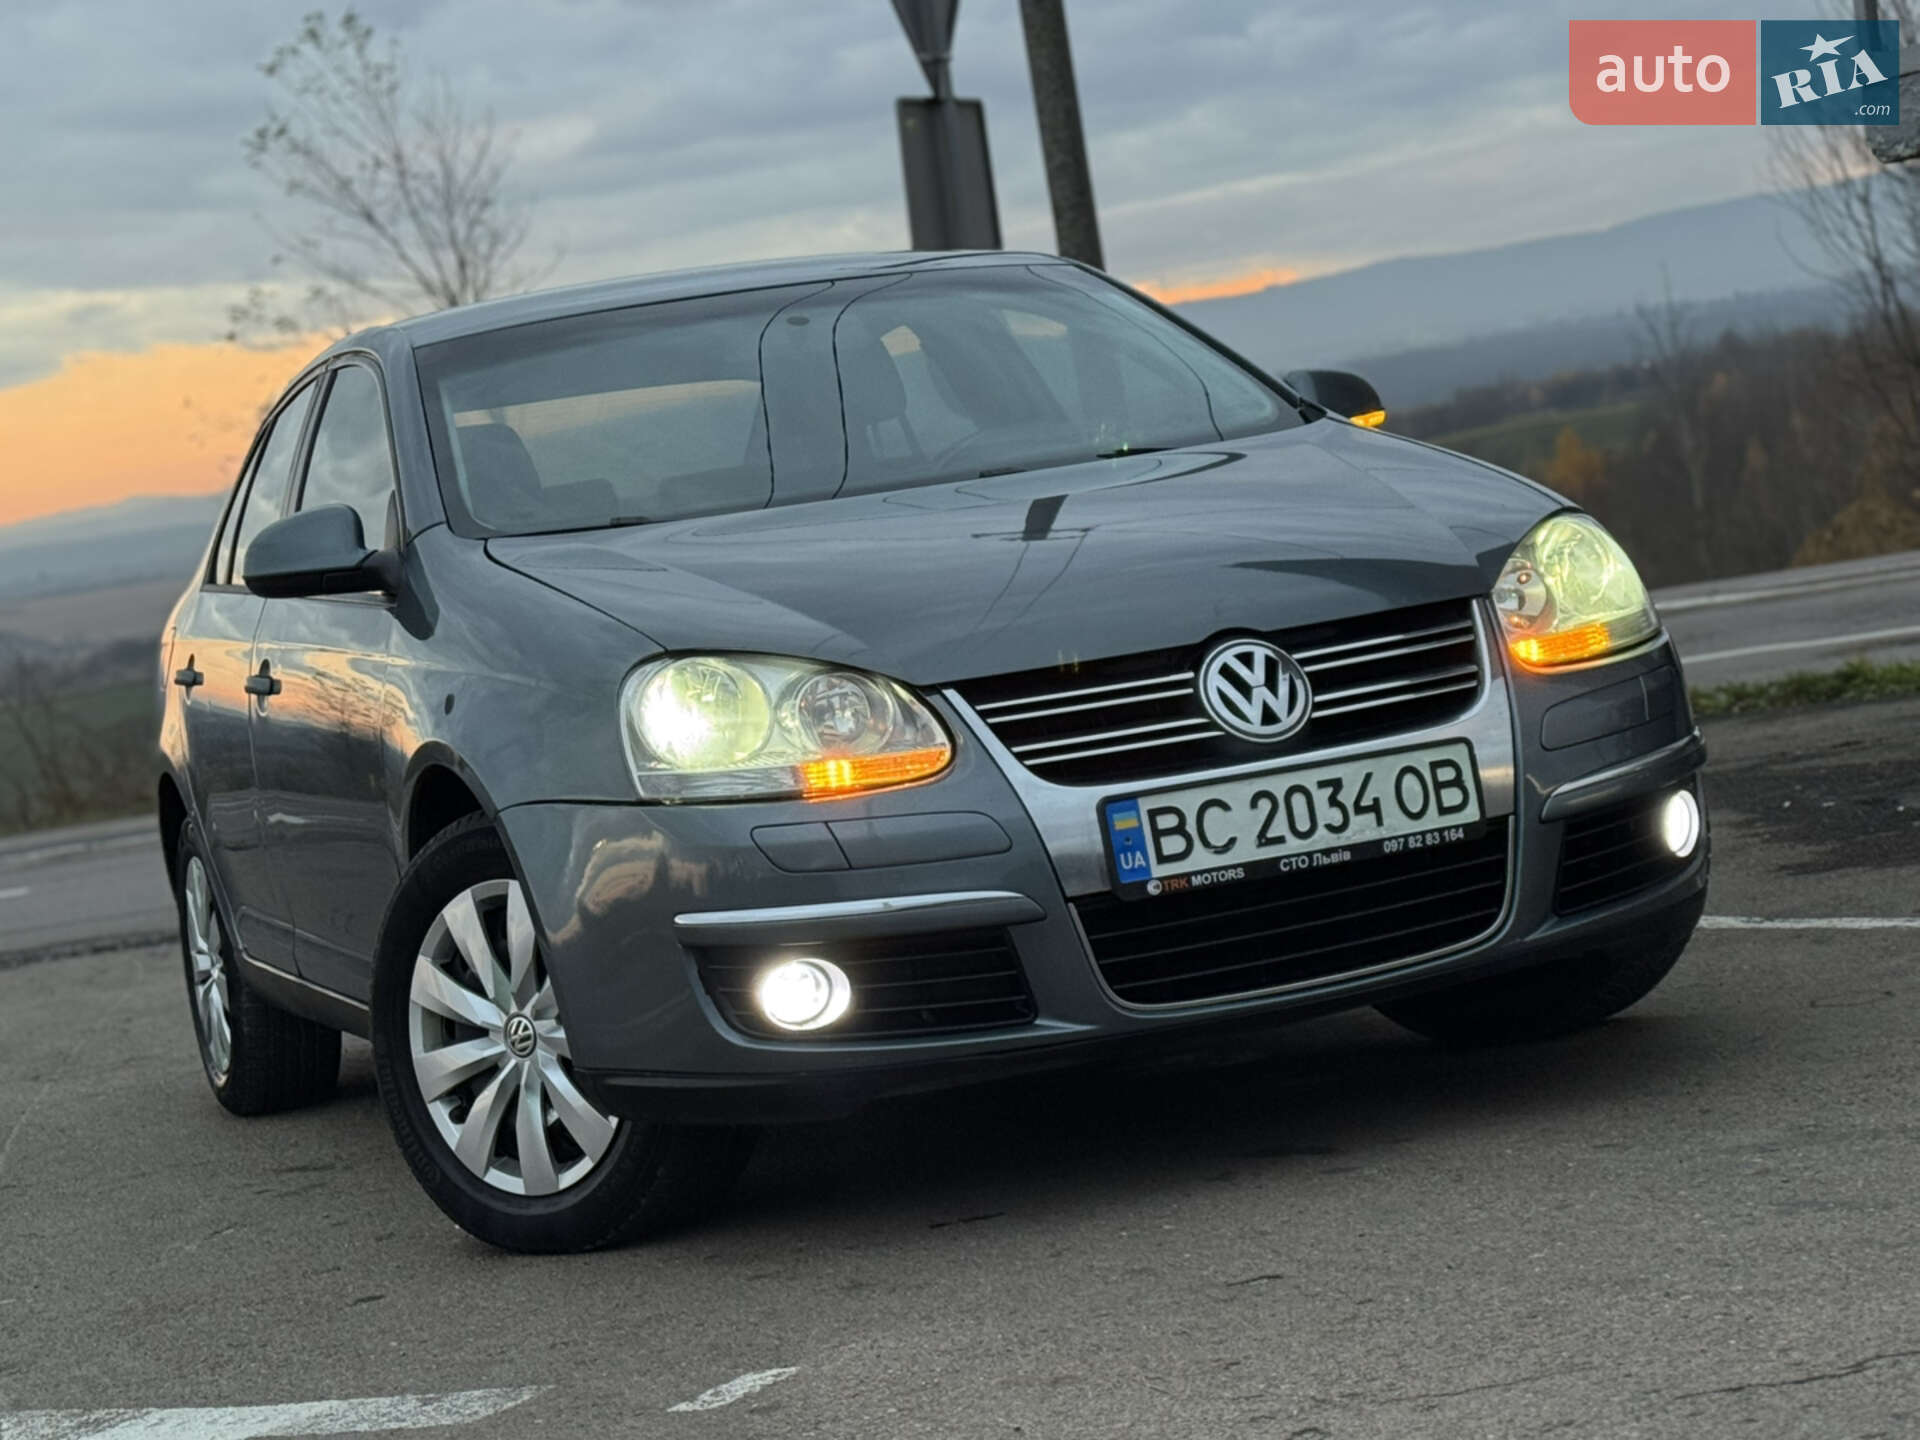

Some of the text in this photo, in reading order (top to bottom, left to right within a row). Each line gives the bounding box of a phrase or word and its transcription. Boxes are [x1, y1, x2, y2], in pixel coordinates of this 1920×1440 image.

[1146, 758, 1471, 865] BC 2034 OB
[1383, 827, 1465, 854] 097 82 83 164
[1119, 852, 1147, 871] UA
[1280, 849, 1351, 872] СТО Львів
[1163, 867, 1246, 892] TRK MOTORS
